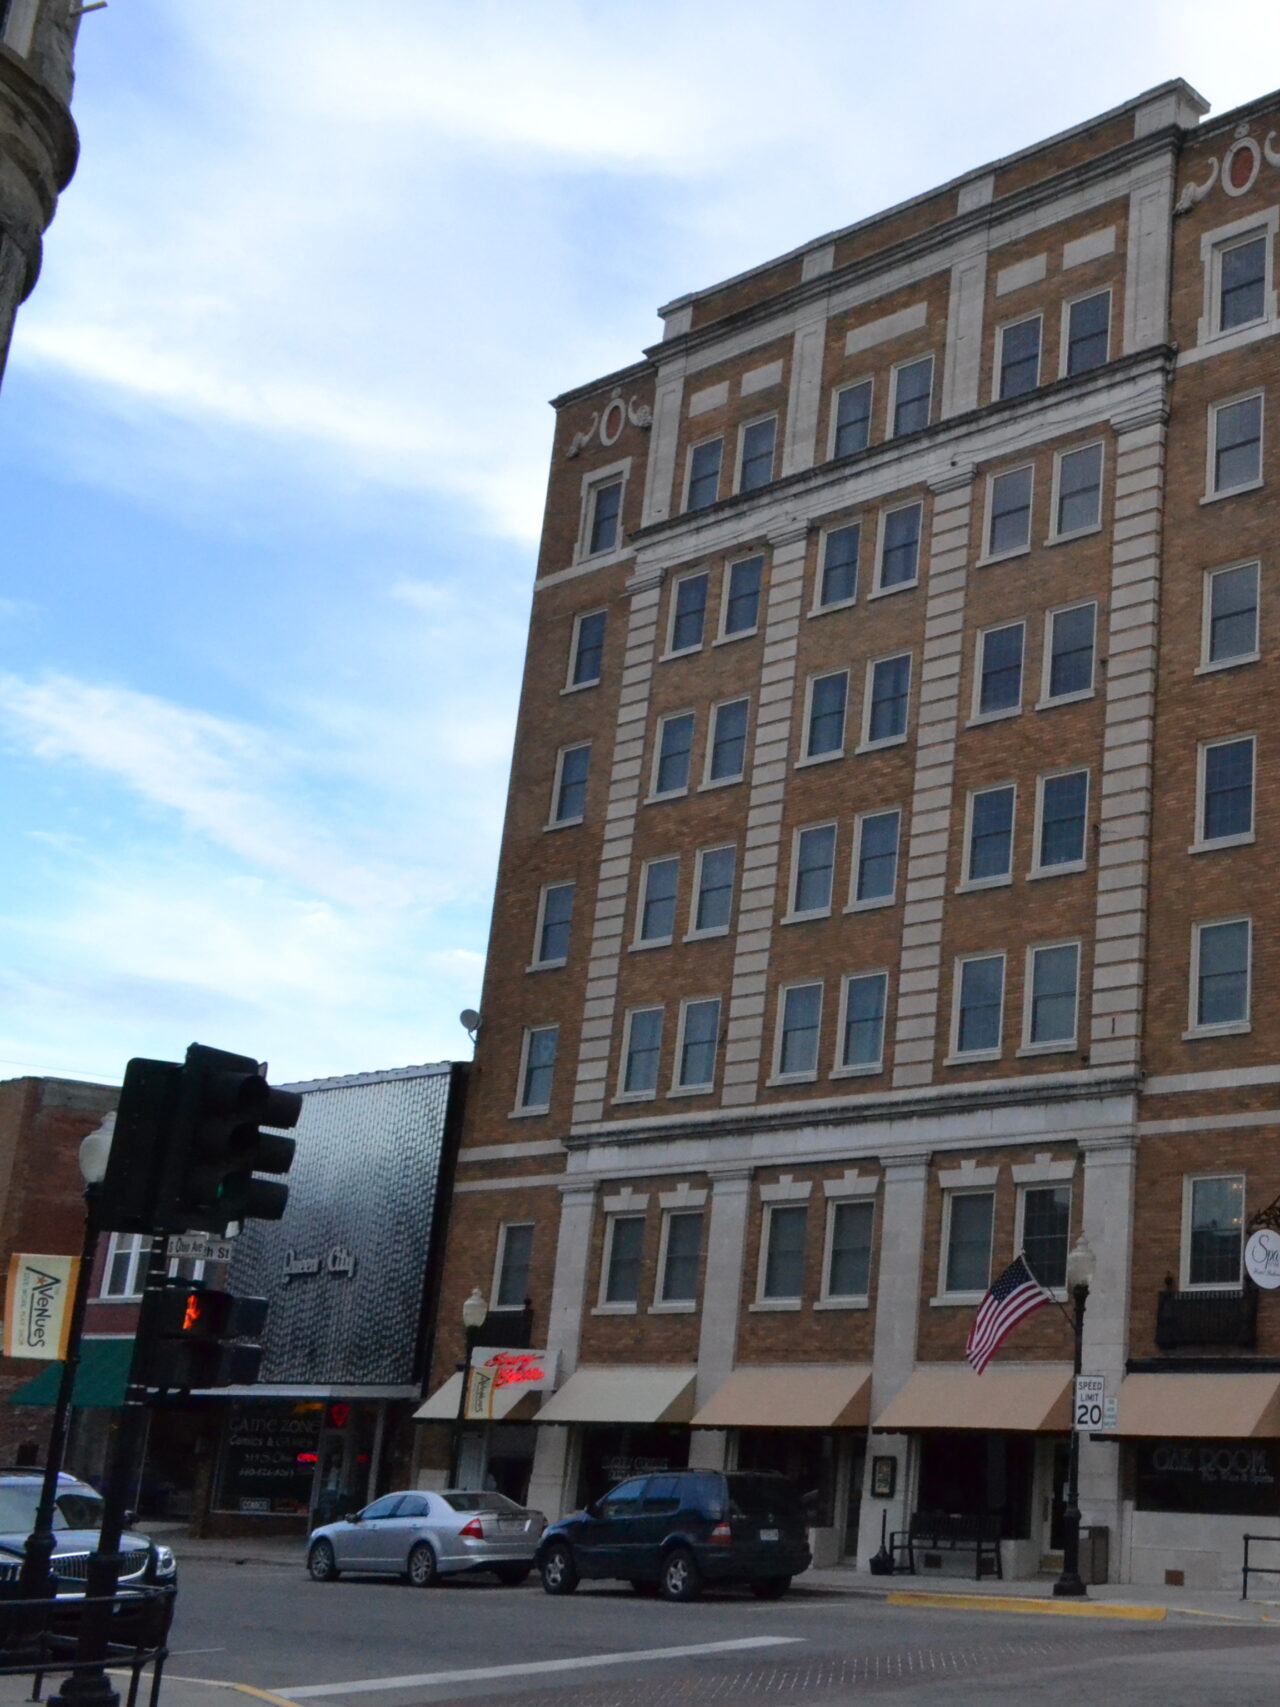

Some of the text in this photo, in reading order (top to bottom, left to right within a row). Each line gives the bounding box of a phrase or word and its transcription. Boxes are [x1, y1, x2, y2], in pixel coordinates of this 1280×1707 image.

[192, 1240, 204, 1253] Ave
[217, 1246, 230, 1259] St
[1251, 1234, 1280, 1270] Spa
[284, 1246, 356, 1283] Queen City
[1078, 1381, 1103, 1391] SPEED
[1080, 1393, 1099, 1402] LIMIT
[1077, 1404, 1102, 1425] 20
[280, 1418, 320, 1434] ZONE
[1152, 1448, 1267, 1473] OAK ROOM
